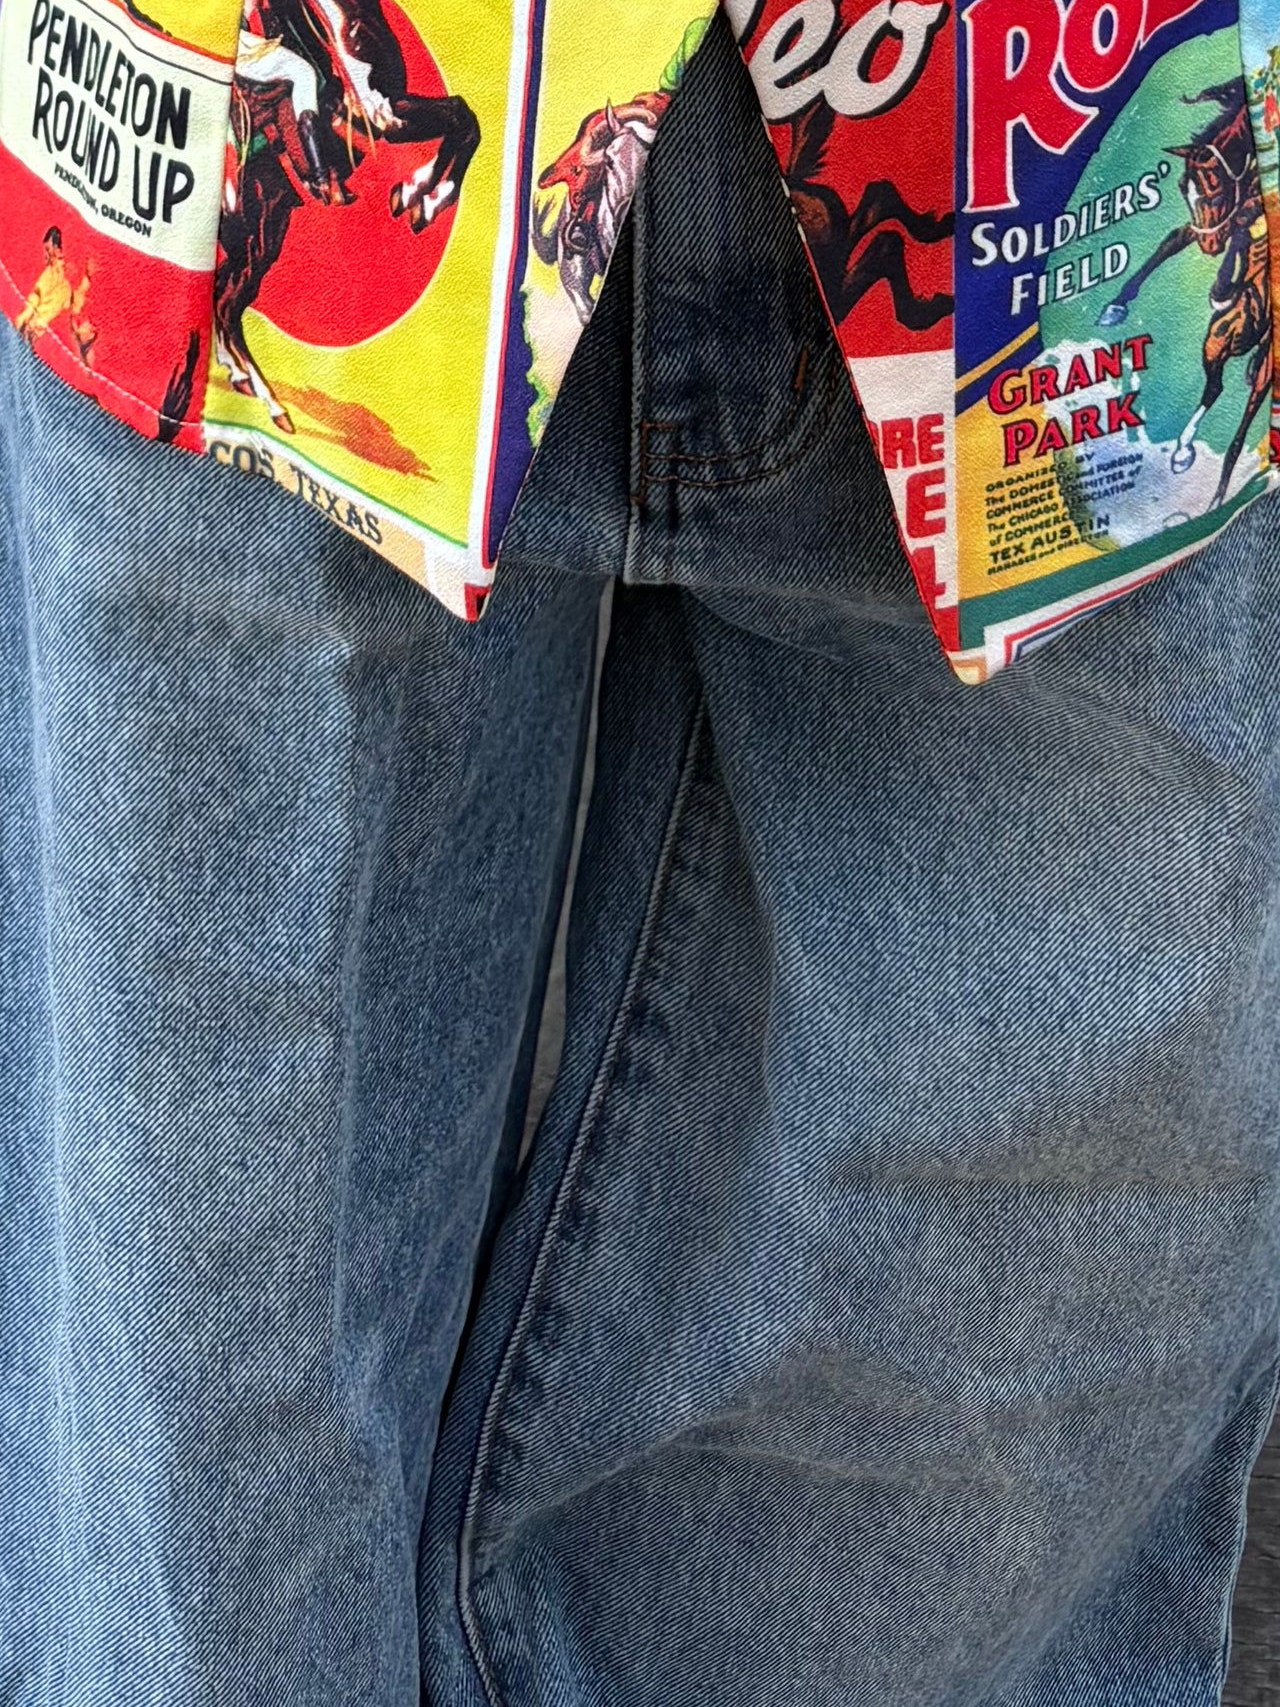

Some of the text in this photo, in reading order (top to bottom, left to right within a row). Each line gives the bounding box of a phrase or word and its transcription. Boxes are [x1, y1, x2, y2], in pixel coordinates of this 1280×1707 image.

[32, 66, 195, 225] ROUND UP
[100, 203, 152, 238] OREGON
[971, 159, 1172, 267] SOLDIERS'
[1010, 240, 1131, 316] FIELD
[987, 333, 1153, 416] GRANT
[1002, 389, 1146, 468] PARK
[288, 462, 383, 546] TEXAS
[985, 490, 1055, 520] COMMERCE
[988, 535, 1002, 548] of
[989, 513, 1111, 565] TEX AUSTIN
[1008, 502, 1059, 527] CHICAGO
